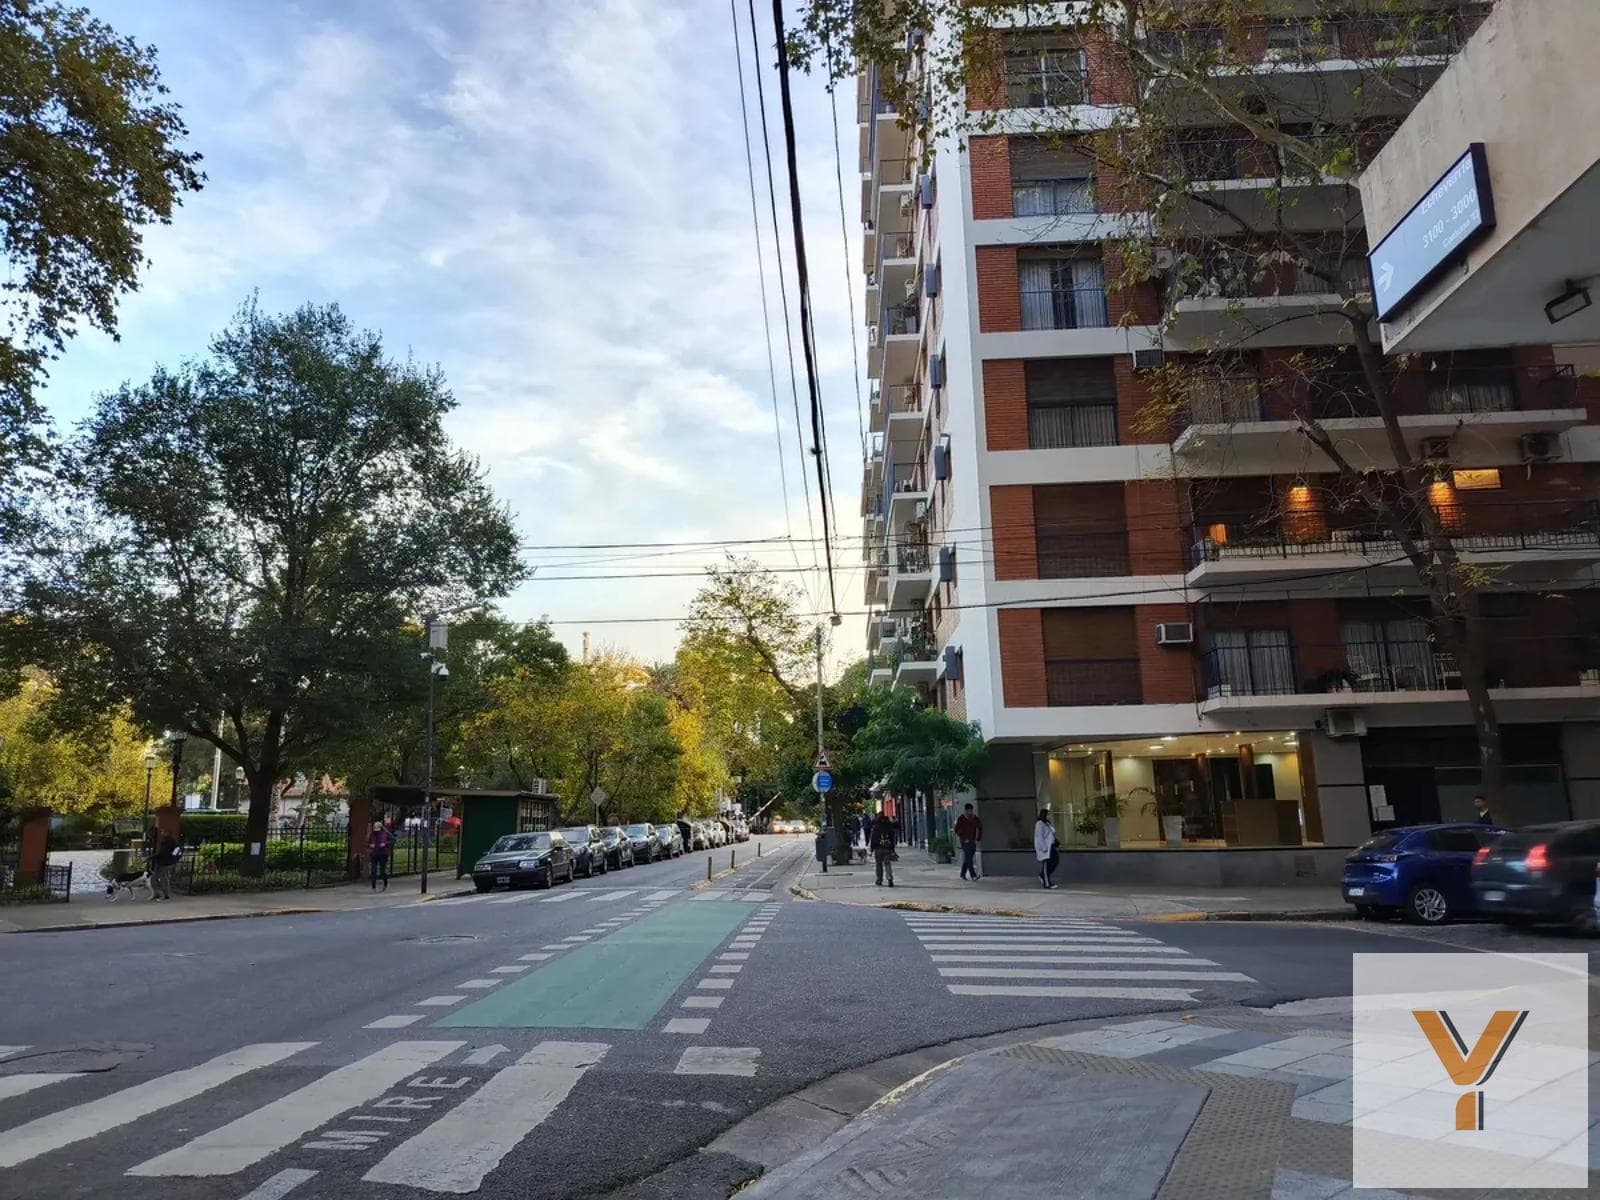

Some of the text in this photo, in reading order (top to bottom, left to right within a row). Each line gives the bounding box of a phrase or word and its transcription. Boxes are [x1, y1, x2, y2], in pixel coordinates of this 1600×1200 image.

[1422, 219, 1444, 248] 3100
[1450, 188, 1477, 219] 3000
[301, 1076, 473, 1151] MIRE
